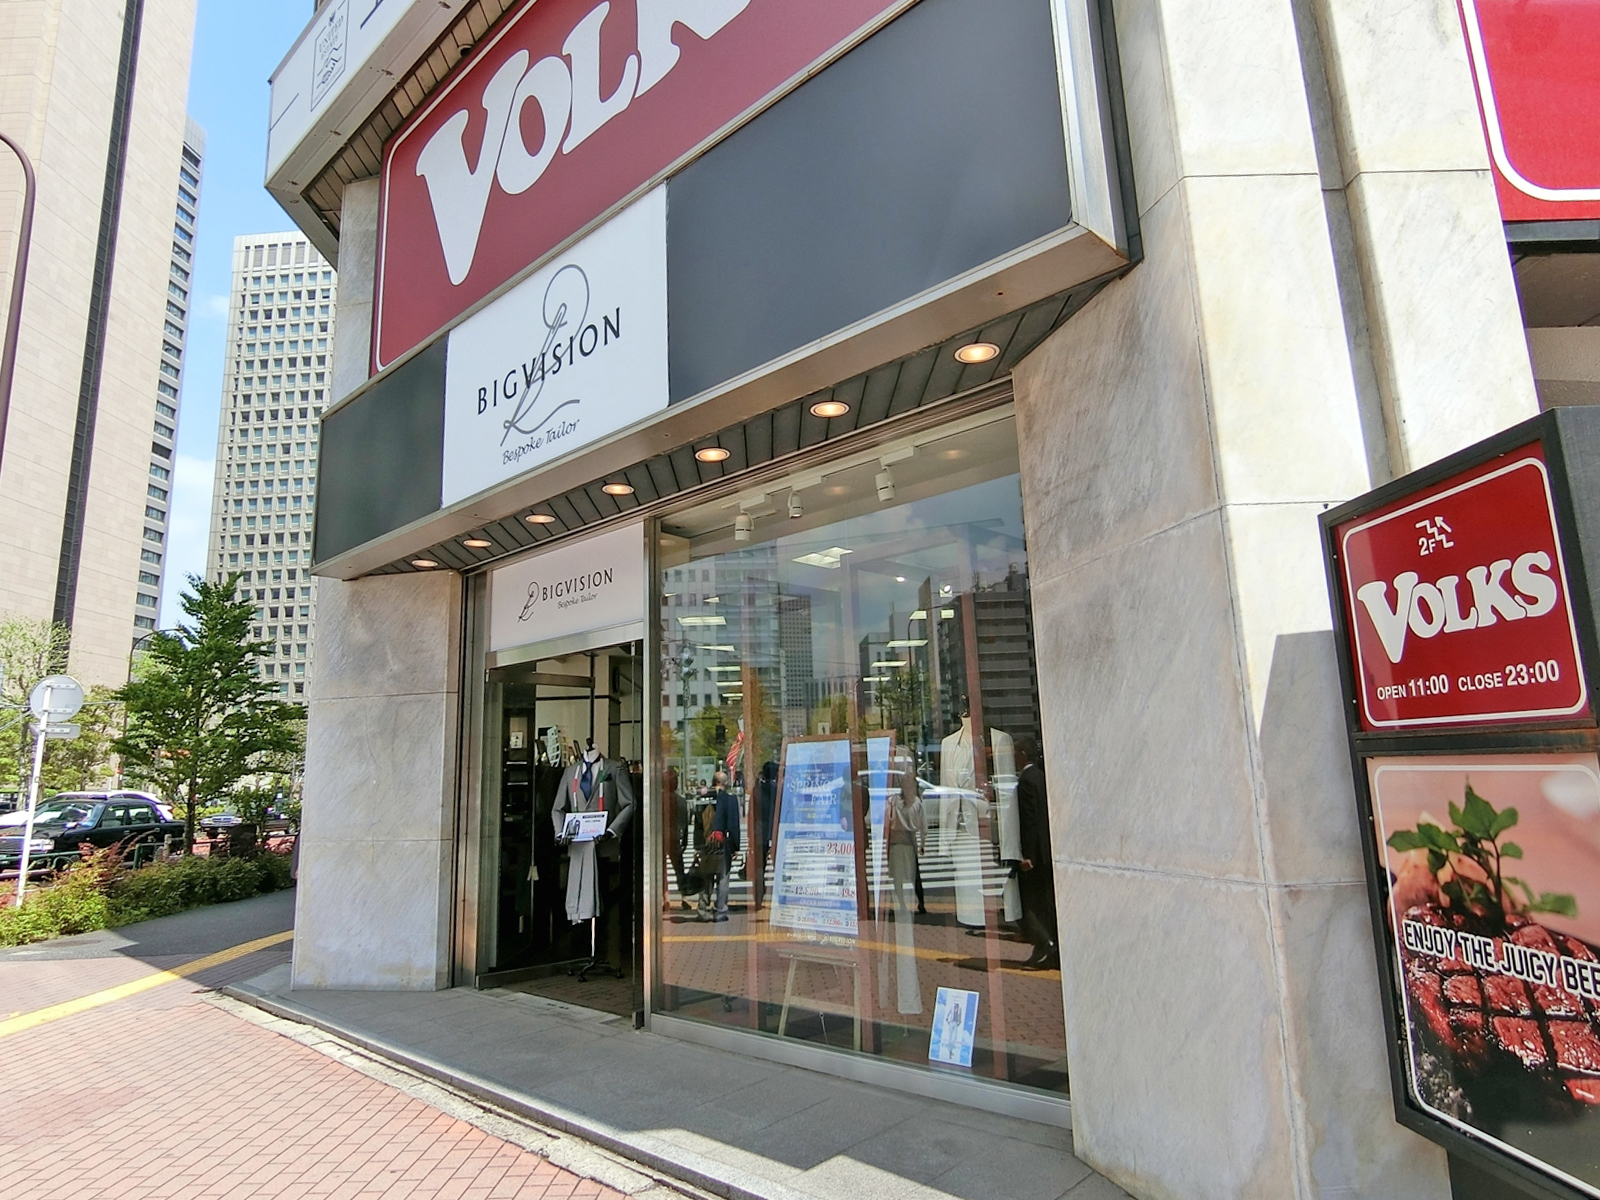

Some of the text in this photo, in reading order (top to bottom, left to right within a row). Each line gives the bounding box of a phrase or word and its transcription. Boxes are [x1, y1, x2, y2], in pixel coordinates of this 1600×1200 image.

[477, 307, 621, 415] BIGVISION
[502, 419, 580, 465] Bespoke Tailor
[1418, 537, 1436, 556] 2F
[542, 568, 613, 601] BIGVISION
[557, 592, 598, 610] Bespoke Tailor
[1357, 550, 1557, 663] VOLKS
[1377, 659, 1560, 700] OPEN 11:00 CLOSE 23:00
[789, 780, 830, 792] SPRING
[810, 793, 837, 805] FAIR
[1402, 920, 1455, 959] ENJOY
[1457, 932, 1496, 970] THE
[1500, 942, 1558, 987] JUICY
